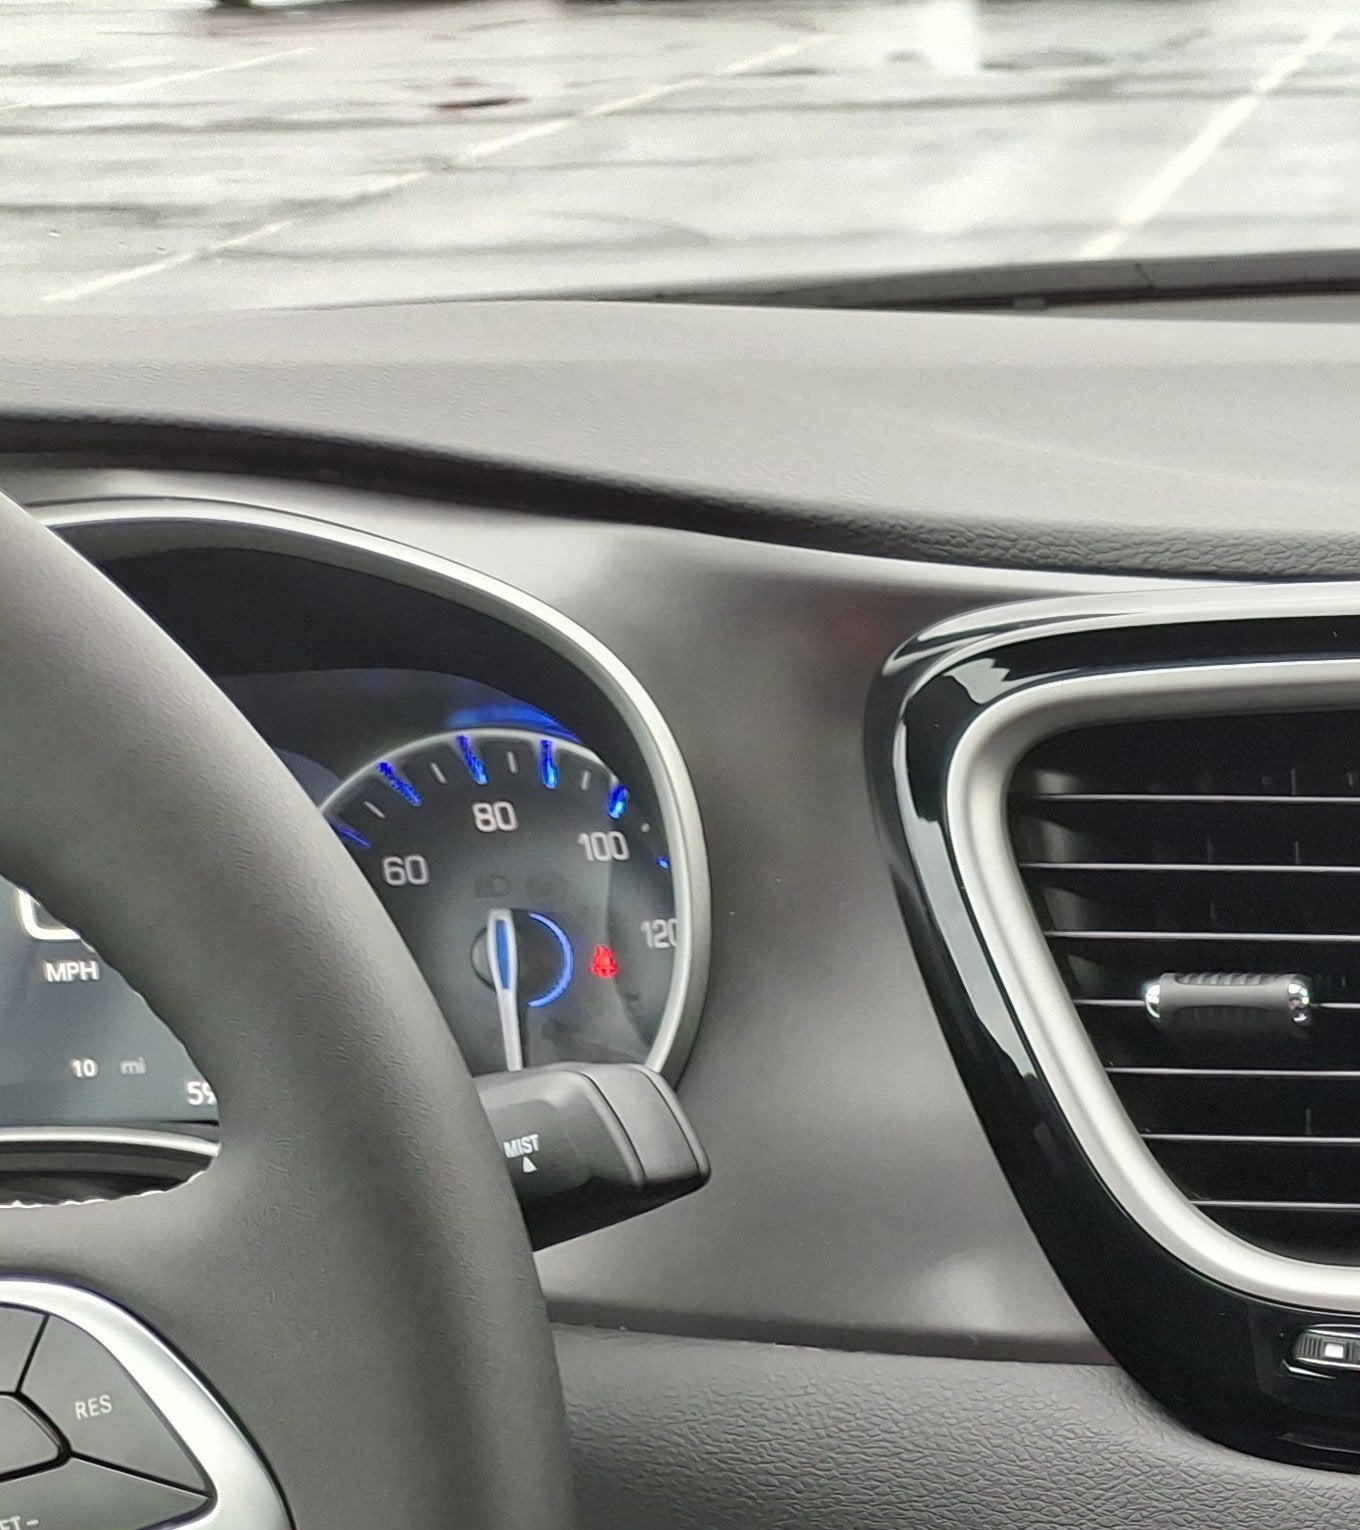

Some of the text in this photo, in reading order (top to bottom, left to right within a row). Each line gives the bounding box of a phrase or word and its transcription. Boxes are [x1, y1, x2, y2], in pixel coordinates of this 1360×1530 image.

[474, 801, 518, 832] 80
[577, 831, 630, 861] 100
[382, 856, 430, 886] 60
[44, 960, 100, 982] MPH
[71, 1058, 97, 1078] 10
[504, 1133, 539, 1157] MIST
[74, 1395, 113, 1420] RES
